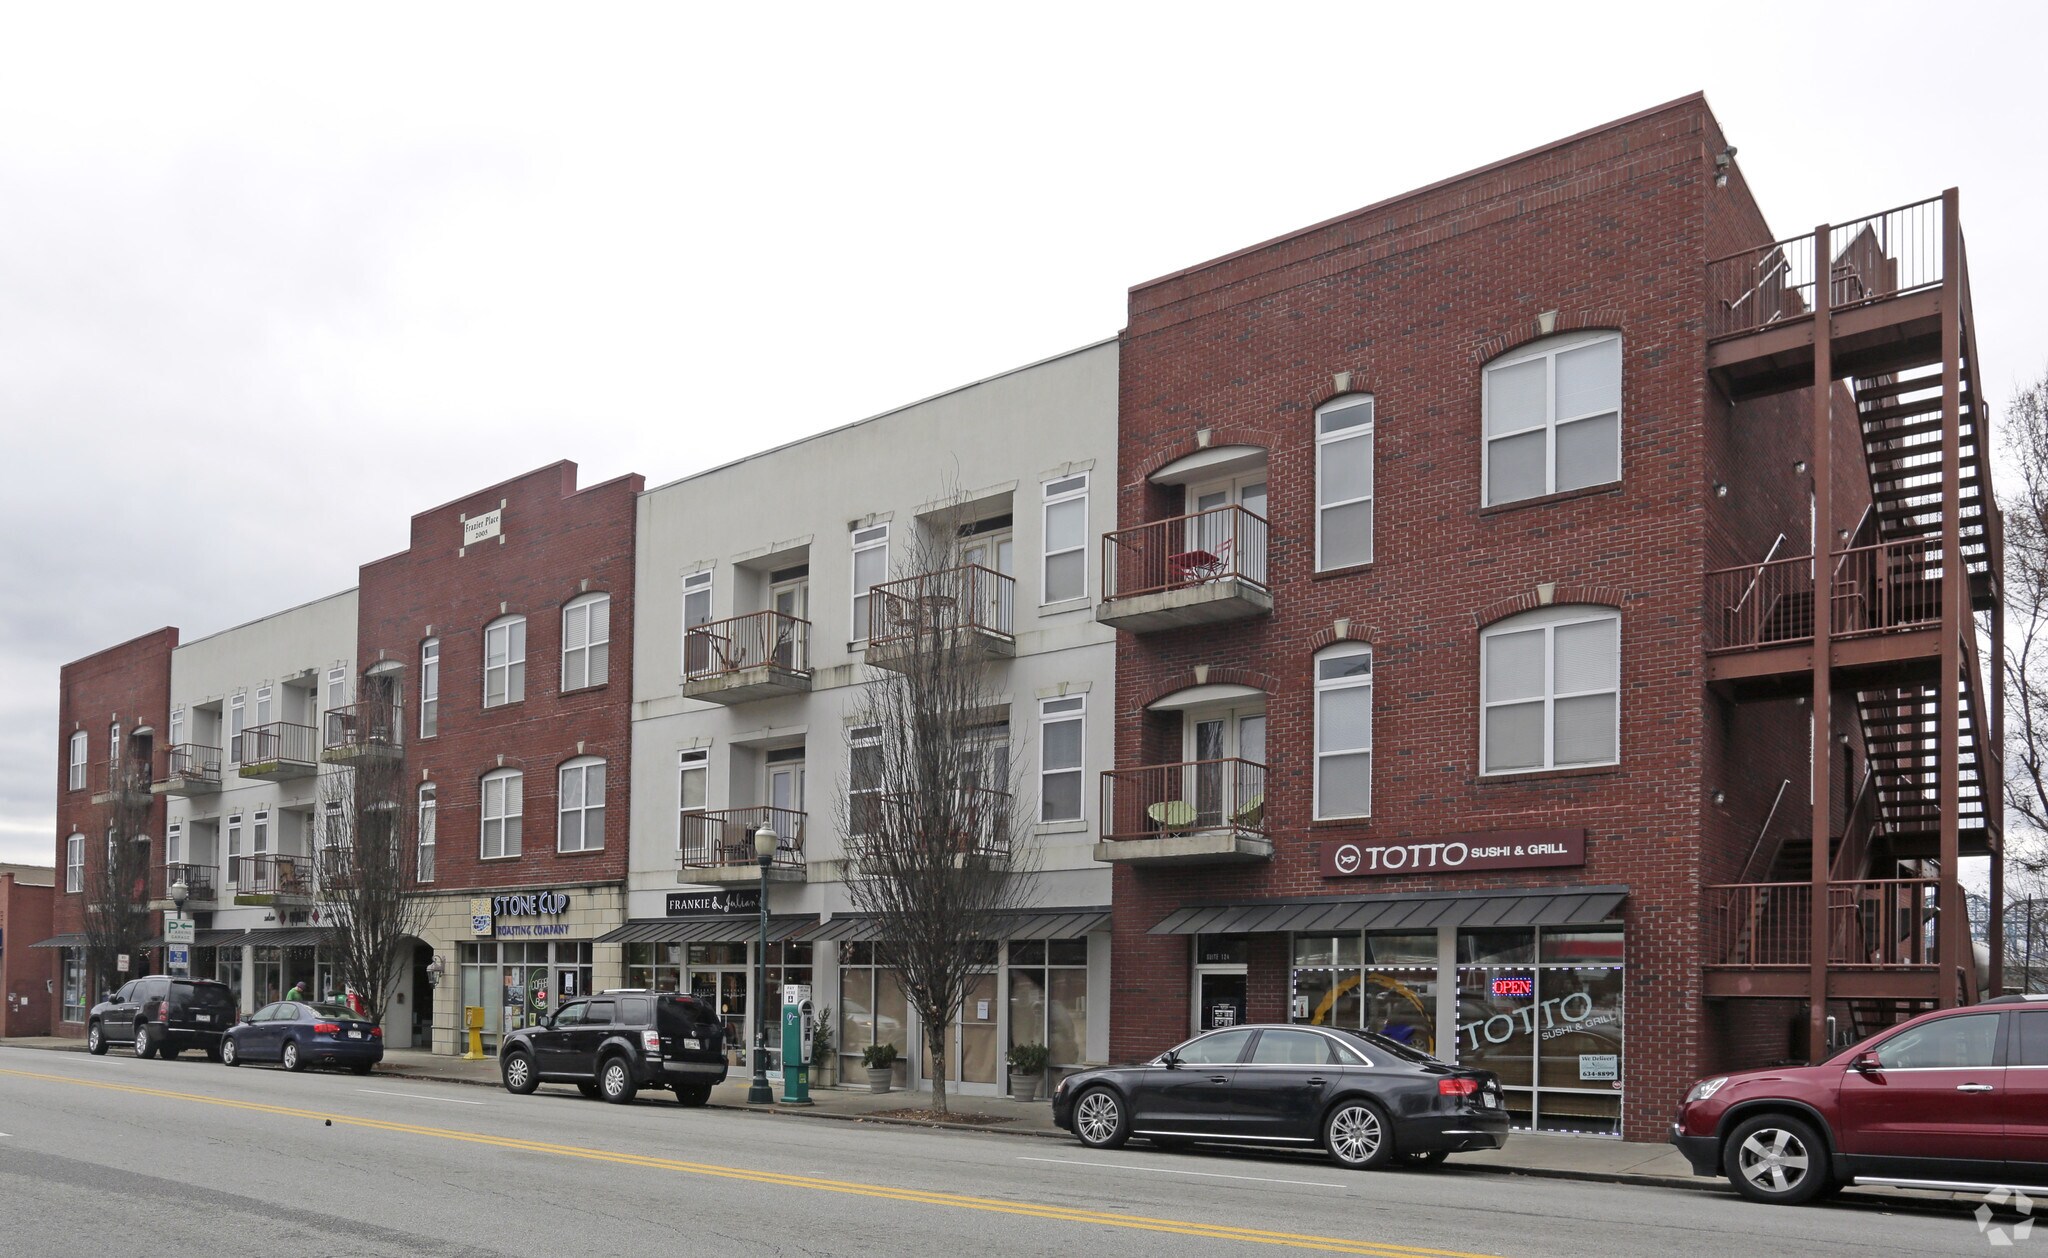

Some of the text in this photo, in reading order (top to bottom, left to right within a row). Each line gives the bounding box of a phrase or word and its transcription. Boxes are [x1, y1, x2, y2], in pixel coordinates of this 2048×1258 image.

[485, 516, 499, 526] Place
[1365, 842, 1568, 870] TOTTO SUSHI & GRILL
[493, 891, 568, 916] STONE CUP
[669, 898, 710, 910] FRANKIE
[711, 896, 723, 910] &
[497, 923, 569, 936] ROASTING COMPANY
[1493, 980, 1531, 994] OPEN
[1460, 992, 1592, 1050] TOTTO
[1541, 1013, 1617, 1041] SUSHI & GRILL
